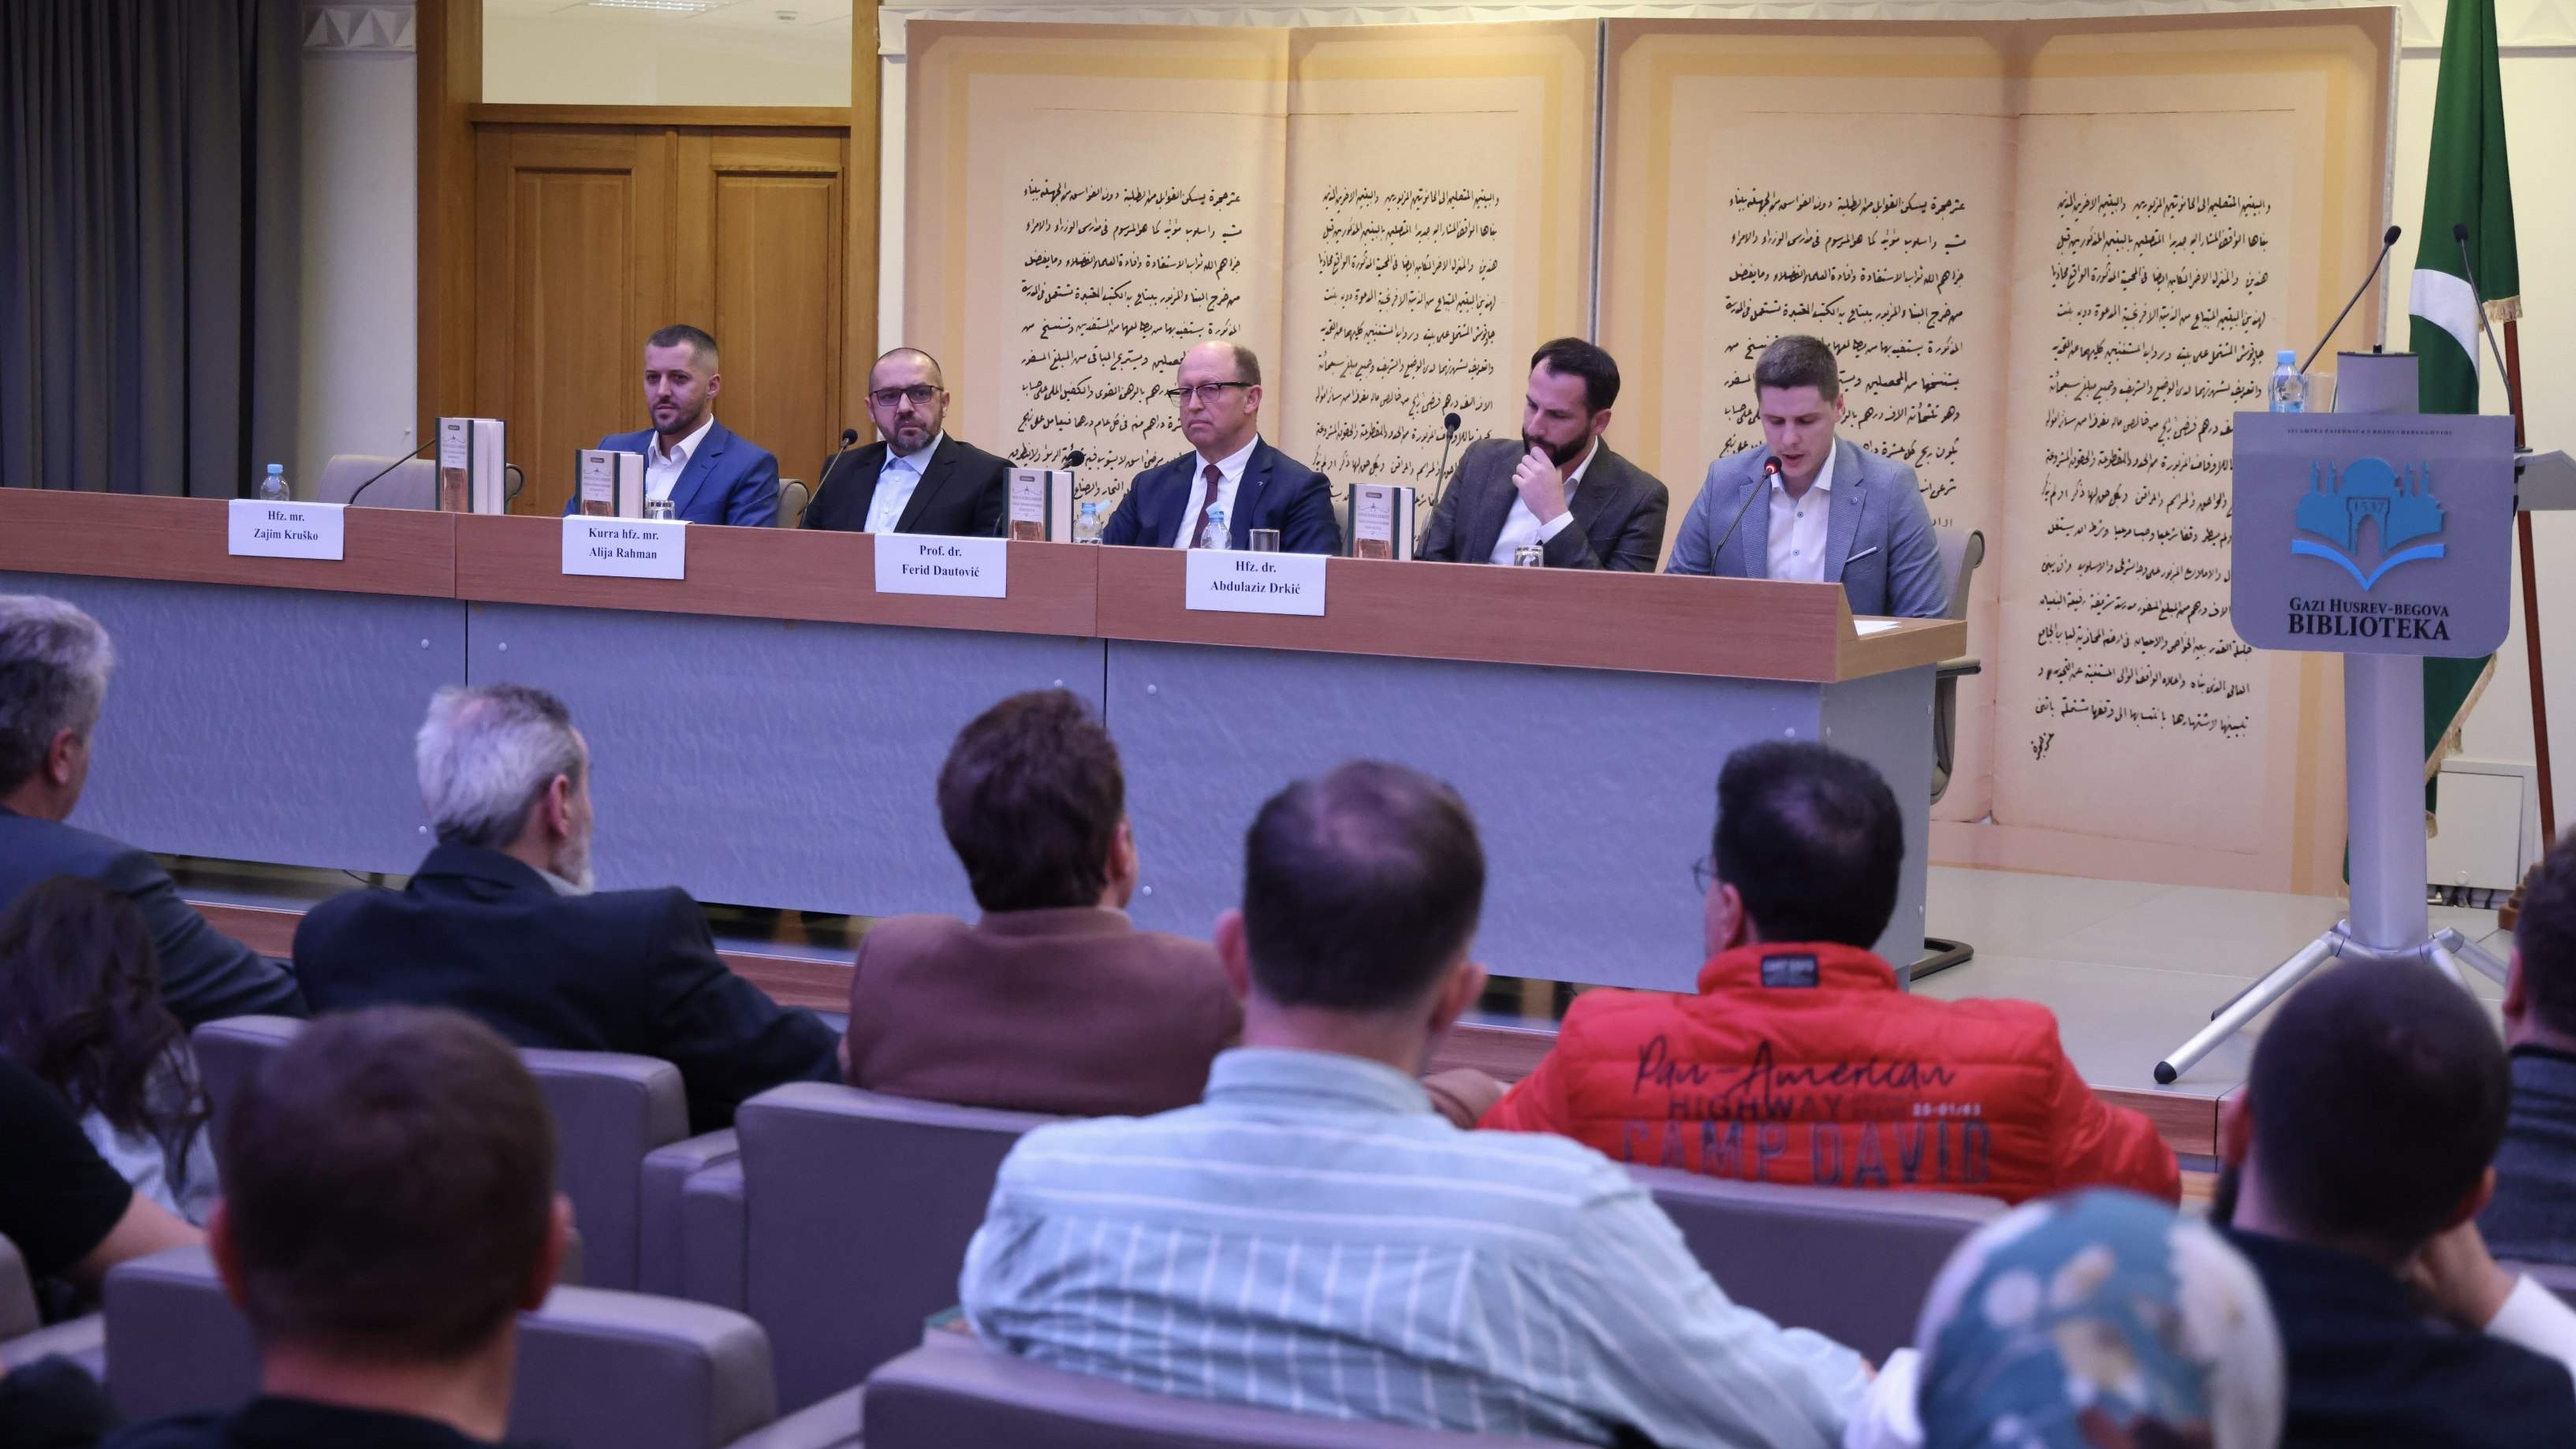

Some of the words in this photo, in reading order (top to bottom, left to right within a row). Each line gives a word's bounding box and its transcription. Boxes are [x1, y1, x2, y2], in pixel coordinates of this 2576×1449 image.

[268, 510, 287, 521] Hfz.
[289, 513, 305, 522] mr.
[254, 528, 281, 541] Zajim
[284, 529, 319, 541] Kruško
[589, 527, 619, 538] Kurra
[621, 529, 640, 539] hfz.
[589, 546, 613, 560] Alija
[616, 547, 657, 559] Rahman
[920, 545, 945, 556] Prof.
[948, 546, 962, 557] dr.
[902, 564, 930, 576] Ferid
[934, 564, 980, 577] Dautović
[1236, 561, 1258, 572] Hfz.
[1262, 561, 1277, 573] dr.
[1210, 580, 1266, 593] Abdulaziz
[1269, 582, 1300, 594] Drkić
[2287, 613, 2451, 641] BIBLIOTEKA
[1635, 1034, 1956, 1108] Pan-American
[1669, 1093, 1844, 1120] HIGHWAY
[1622, 1119, 1787, 1181] CAMP
[1810, 1119, 1991, 1186] DAVID
